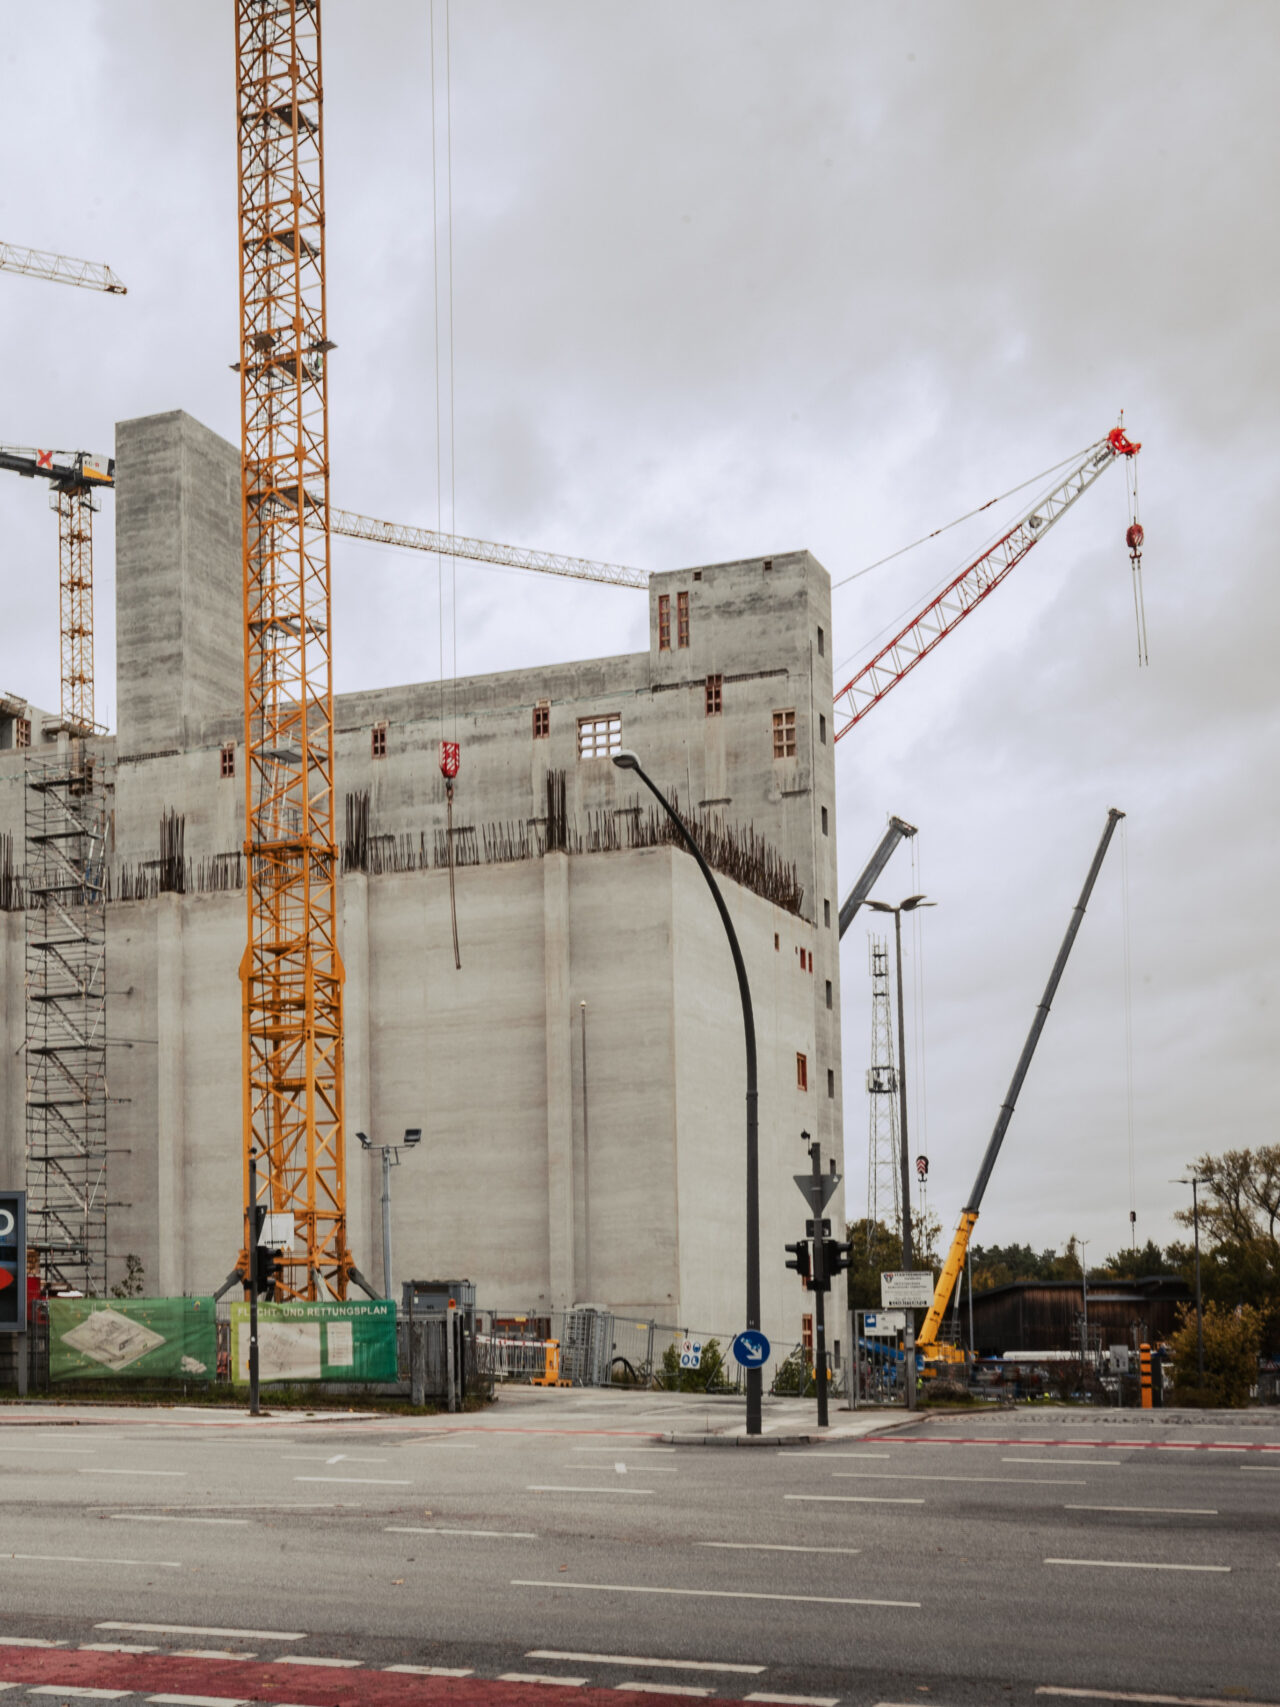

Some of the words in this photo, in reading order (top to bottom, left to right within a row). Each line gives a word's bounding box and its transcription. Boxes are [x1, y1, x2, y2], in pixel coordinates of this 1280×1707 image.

[238, 1308, 280, 1317] FLCHT-
[282, 1308, 304, 1316] UND
[307, 1306, 388, 1316] RETTUNGSPLAN
